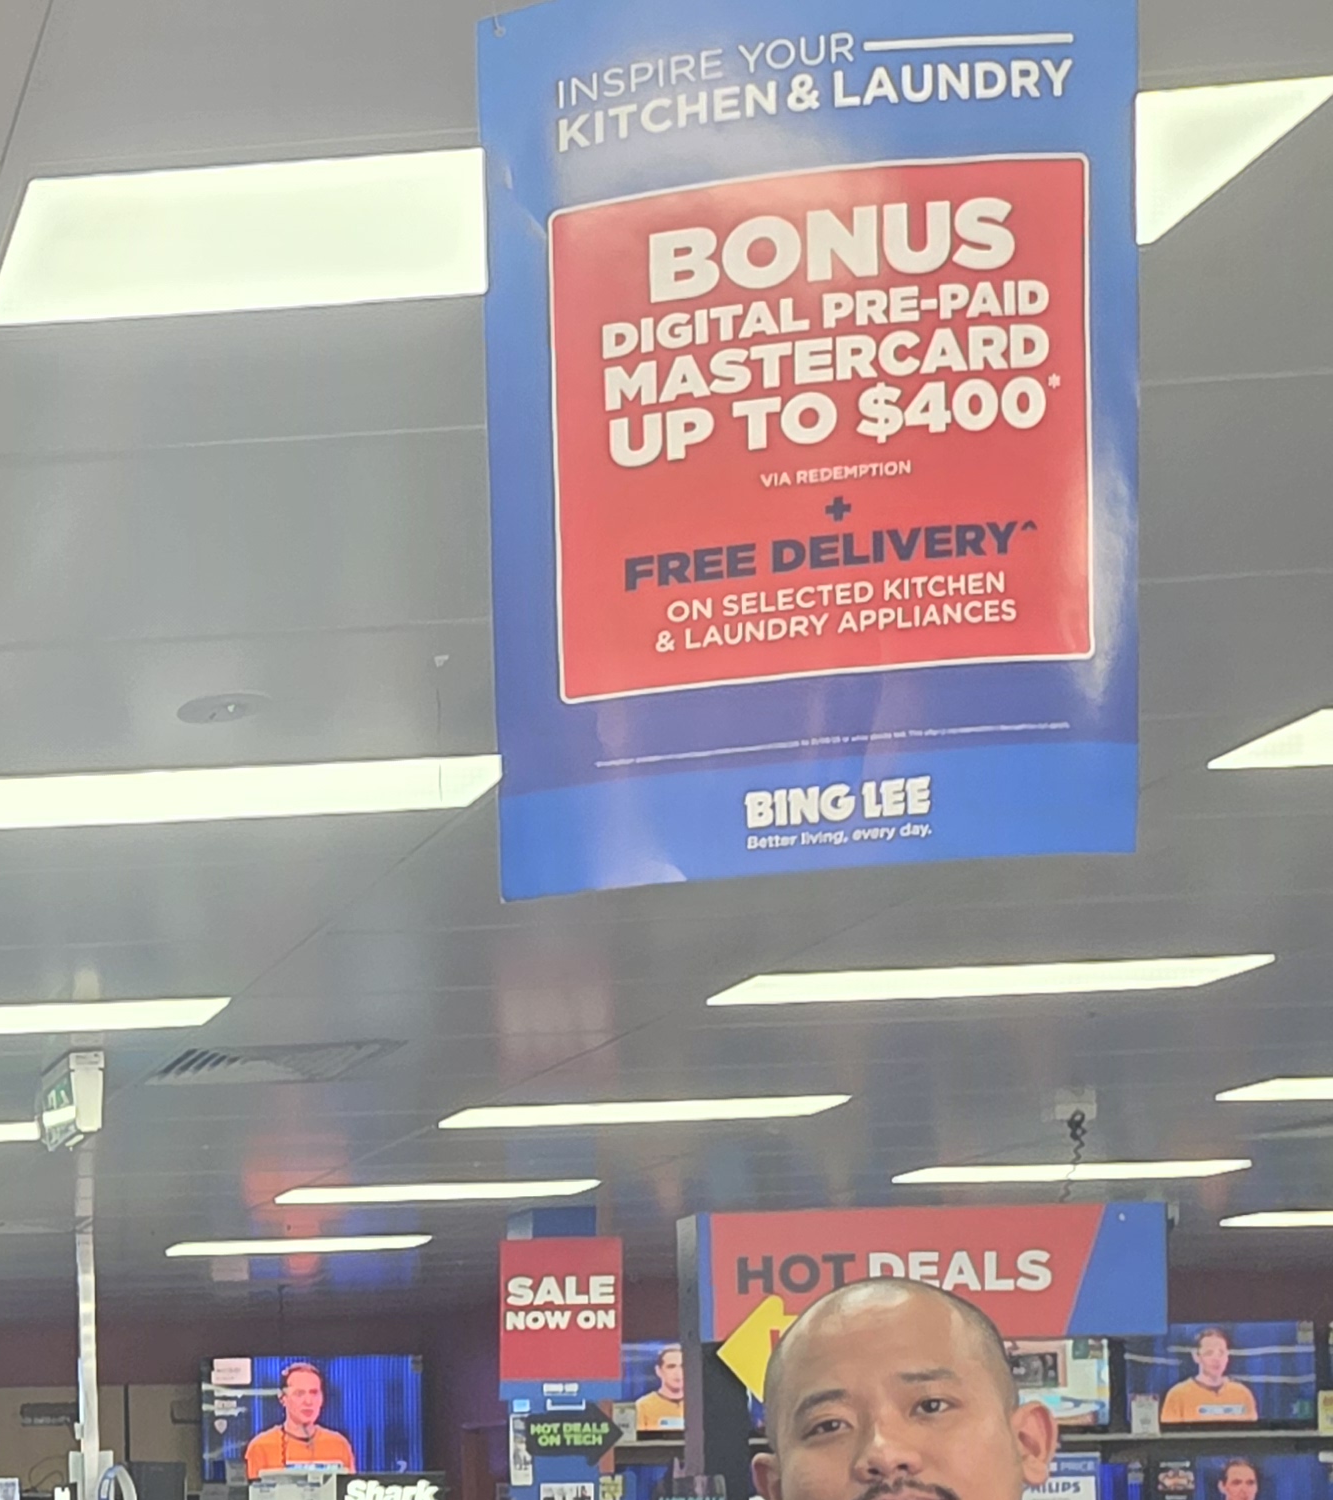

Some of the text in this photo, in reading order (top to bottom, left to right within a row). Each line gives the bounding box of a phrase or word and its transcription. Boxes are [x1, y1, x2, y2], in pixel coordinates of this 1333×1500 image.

[558, 32, 855, 108] INSPIRE YOUR
[558, 58, 1074, 152] KITCHEN & LAUNDRY
[649, 197, 1016, 304] BONUS
[602, 280, 1050, 360] DIGITAL PRE-PAID
[603, 324, 1050, 412] MASTERCARD
[608, 407, 715, 468] UP
[733, 392, 838, 451] TO
[760, 460, 912, 488] VIA REDEMPTION
[624, 543, 757, 593] FREE
[666, 571, 1006, 623] ON SELECTED KITCHEN
[655, 599, 1017, 653] & LAUNDRY APPLIANCES
[744, 775, 931, 829] BING LEE
[746, 822, 932, 850] Better living, every day.
[506, 1275, 615, 1306] SALE
[736, 1250, 1052, 1296] HOT DEALS
[505, 1309, 616, 1331] NOW ON
[530, 1422, 610, 1435] HOT DEALS
[538, 1434, 603, 1447] ON TECH
[1025, 1481, 1081, 1494] HILIPS
